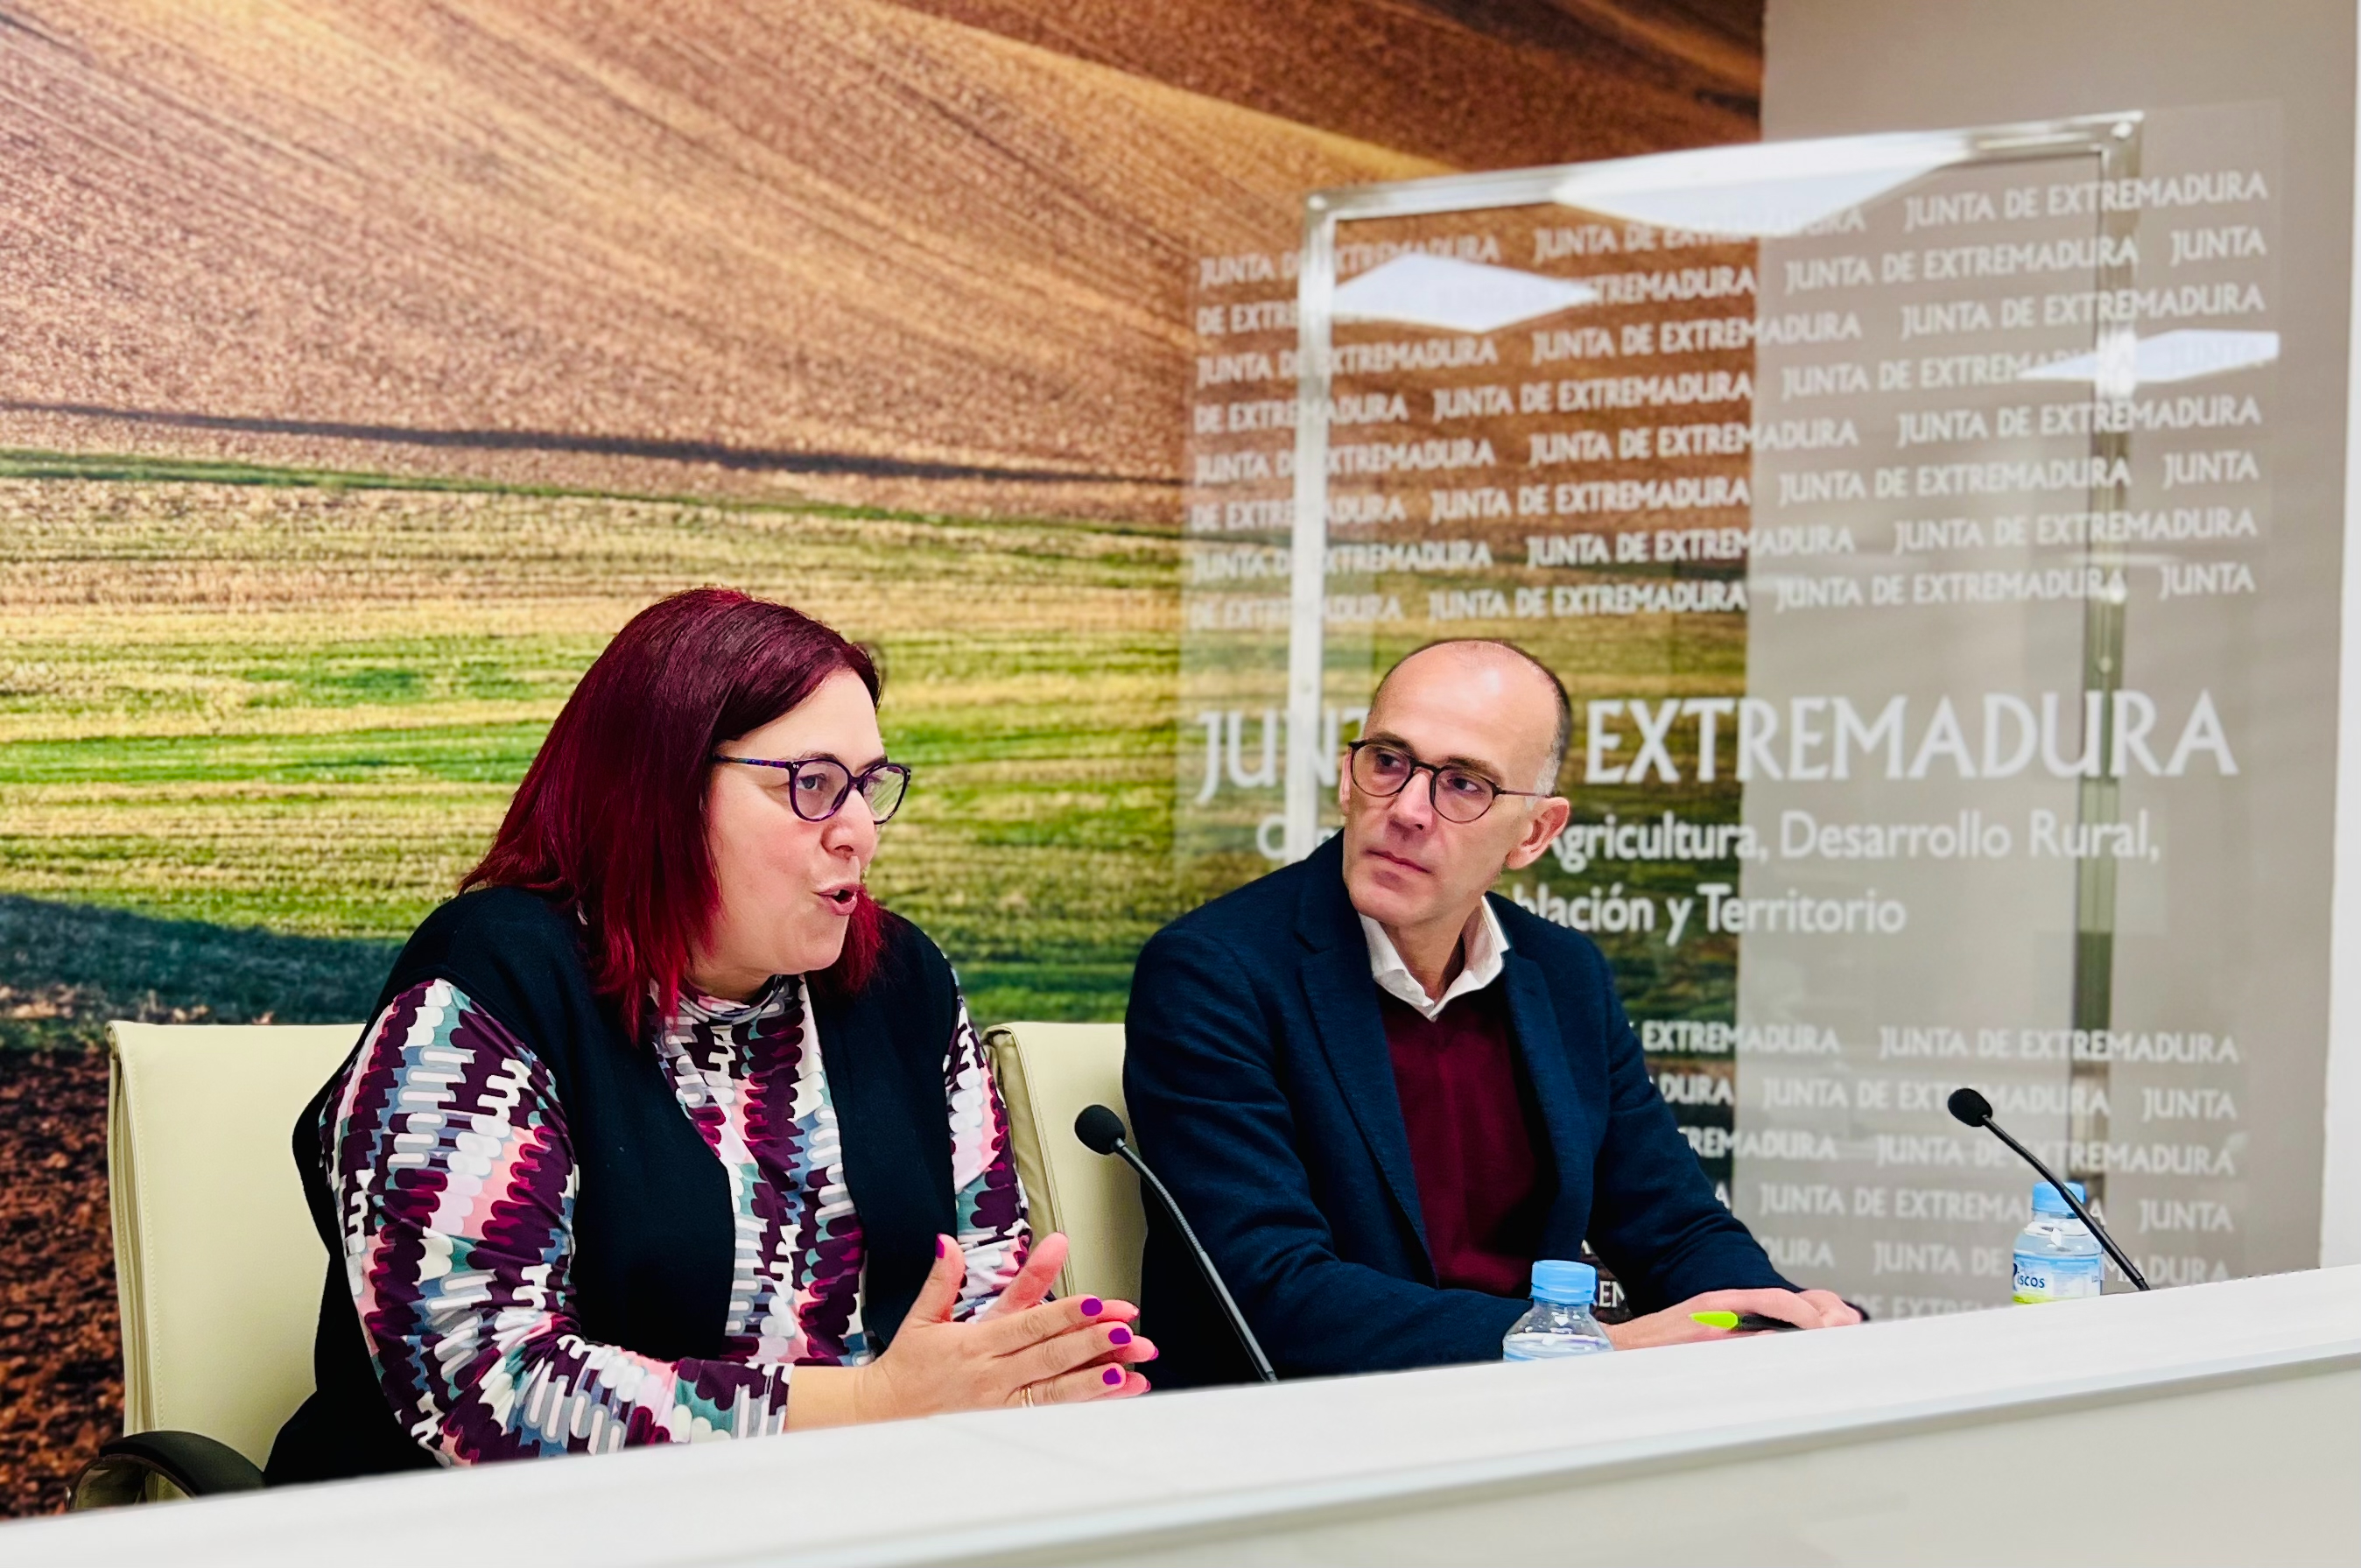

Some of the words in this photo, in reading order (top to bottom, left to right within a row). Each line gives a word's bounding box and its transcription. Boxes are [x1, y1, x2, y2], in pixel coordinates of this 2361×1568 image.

[1200, 251, 1275, 292] JUNTA
[1532, 224, 1618, 266] JUNTA
[1626, 221, 1655, 252] DE
[1905, 192, 1996, 232] JUNTA
[2005, 186, 2039, 218] DE
[2047, 172, 2267, 216] EXTREMADURA
[1197, 306, 1225, 335] DE
[1784, 256, 1873, 295] JUNTA
[1881, 250, 1916, 284] DE
[1922, 236, 2140, 280] EXTREMADURA
[2170, 226, 2266, 265] JUNTA
[1197, 353, 1272, 390] JUNTA
[1532, 329, 1613, 367] JUNTA
[1621, 322, 1654, 356] DE
[1662, 311, 1862, 352] EXTREMADURA
[1901, 300, 1992, 341] JUNTA
[2000, 295, 2035, 328] DE
[2043, 284, 2266, 326] EXTREMADURA
[1194, 404, 1224, 434] DE
[1432, 383, 1513, 420] JUNTA
[1520, 378, 1554, 411] DE
[1558, 369, 1753, 411] EXTREMADURA
[1781, 362, 1869, 400] JUNTA
[1879, 357, 1913, 390] DE
[1195, 451, 1270, 487] JUNTA
[1325, 438, 1495, 476] XTREMADURA
[1529, 434, 1610, 468] JUNTA
[1620, 429, 1652, 460] DE
[1659, 418, 1859, 457] EXTREMADURA
[1898, 410, 1988, 447] JUNTA
[1998, 405, 2032, 437] DE
[2040, 395, 2261, 436] EXTREMADURA
[1191, 503, 1220, 532] DE
[1226, 492, 1406, 531] EXTREADURA
[1430, 487, 1511, 524] JUNTA
[1517, 483, 1549, 517] DE
[1555, 475, 1751, 515] EXTREMADURA
[1778, 470, 1866, 507] JUNTA
[1874, 466, 1908, 497] DE
[1916, 457, 2133, 496] EXTREMADURA
[2162, 451, 2259, 489] JUNTA
[1193, 551, 1268, 585] JUNTA
[1323, 539, 1493, 577] XTREMADURA
[1526, 534, 1609, 569] JUNTA
[1616, 531, 1648, 564] DE
[1654, 524, 1855, 562] EXTREMADURA
[1894, 517, 1985, 555] JUNTA
[1993, 514, 2028, 546] DE
[2035, 507, 2258, 546] EXTREMADURA
[1429, 588, 1509, 623] JUNTA
[1514, 586, 1548, 618] DE
[1552, 579, 1749, 616] EXTREMADURA
[1774, 577, 1863, 612] JUNTA
[1872, 572, 1905, 604] DE
[1913, 565, 2129, 604] EXTREMADURA
[2158, 562, 2256, 600] JUNTA
[1585, 689, 2239, 784] EXTREMADURA
[1781, 810, 2012, 858] Desarrollo
[2029, 809, 2161, 865] Rural,
[1666, 897, 1693, 947] y
[1696, 881, 1907, 933] Territorio
[1642, 1020, 1839, 1054] EXTREMADURA
[1879, 1026, 1968, 1060] JUNTA
[1978, 1028, 2010, 1058] DE
[2020, 1029, 2239, 1064] EXTREMADURA
[1762, 1077, 1849, 1110] JUNTA
[1858, 1081, 1891, 1109] DE
[1898, 1083, 2110, 1116] EXTMADURA
[2141, 1087, 2237, 1122] JUNTA
[1876, 1135, 1964, 1168] JUNTA
[1974, 1137, 2008, 1167] DE
[1759, 1184, 1845, 1216] JUNTA
[1855, 1188, 1886, 1218] DE
[1894, 1189, 2107, 1226] EXTREMAA
[2139, 1199, 2233, 1233] JUNTA
[1873, 1241, 1962, 1276] JUNTA
[1972, 1247, 2005, 1277] DE
